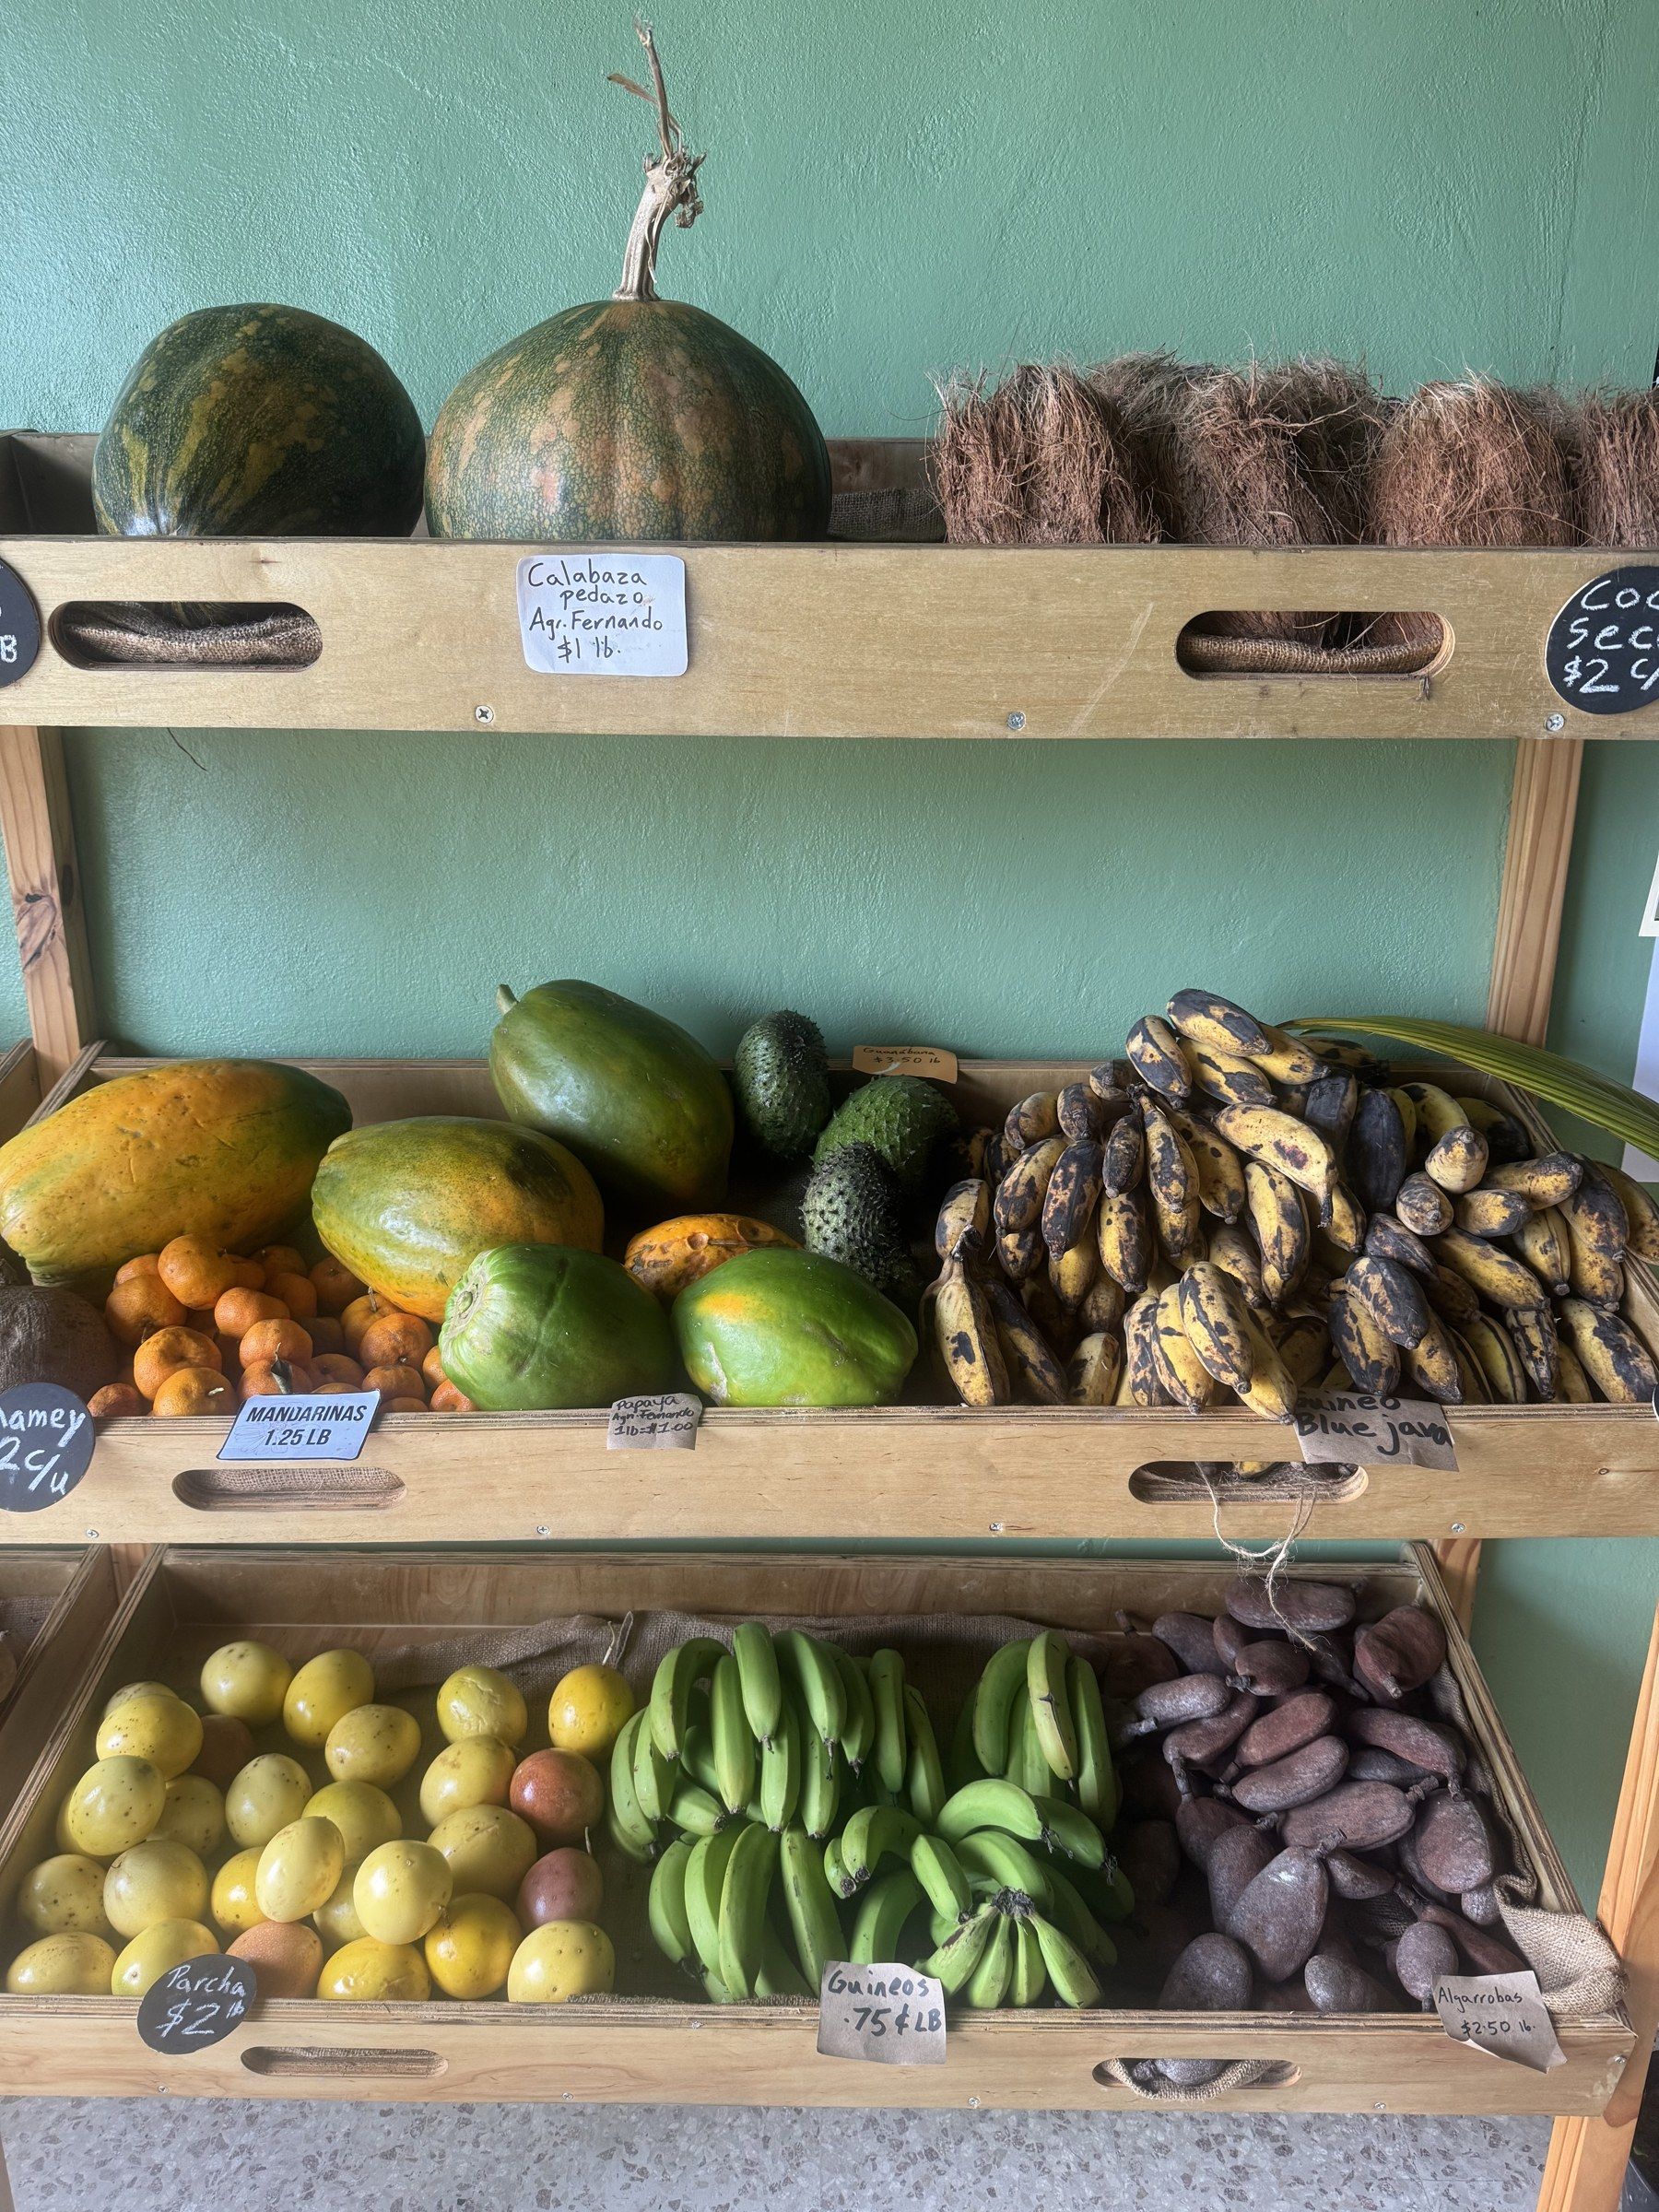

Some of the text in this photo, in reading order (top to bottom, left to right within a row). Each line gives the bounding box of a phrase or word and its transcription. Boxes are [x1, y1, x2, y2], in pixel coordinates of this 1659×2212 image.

[528, 559, 647, 586] Calabaza
[559, 584, 643, 610] pedazo
[571, 606, 663, 630] Fernando
[558, 635, 581, 663] $1
[246, 1406, 367, 1422] MANDARINAS
[1298, 1412, 1377, 1436] Blue
[265, 1429, 332, 1445] 1.25 LB
[167, 1965, 246, 1997] Parcha
[828, 1970, 929, 1998] Guineos
[1438, 1986, 1523, 2013] Algarrobas
[155, 1998, 220, 2038] $2
[915, 2008, 942, 2032] LB
